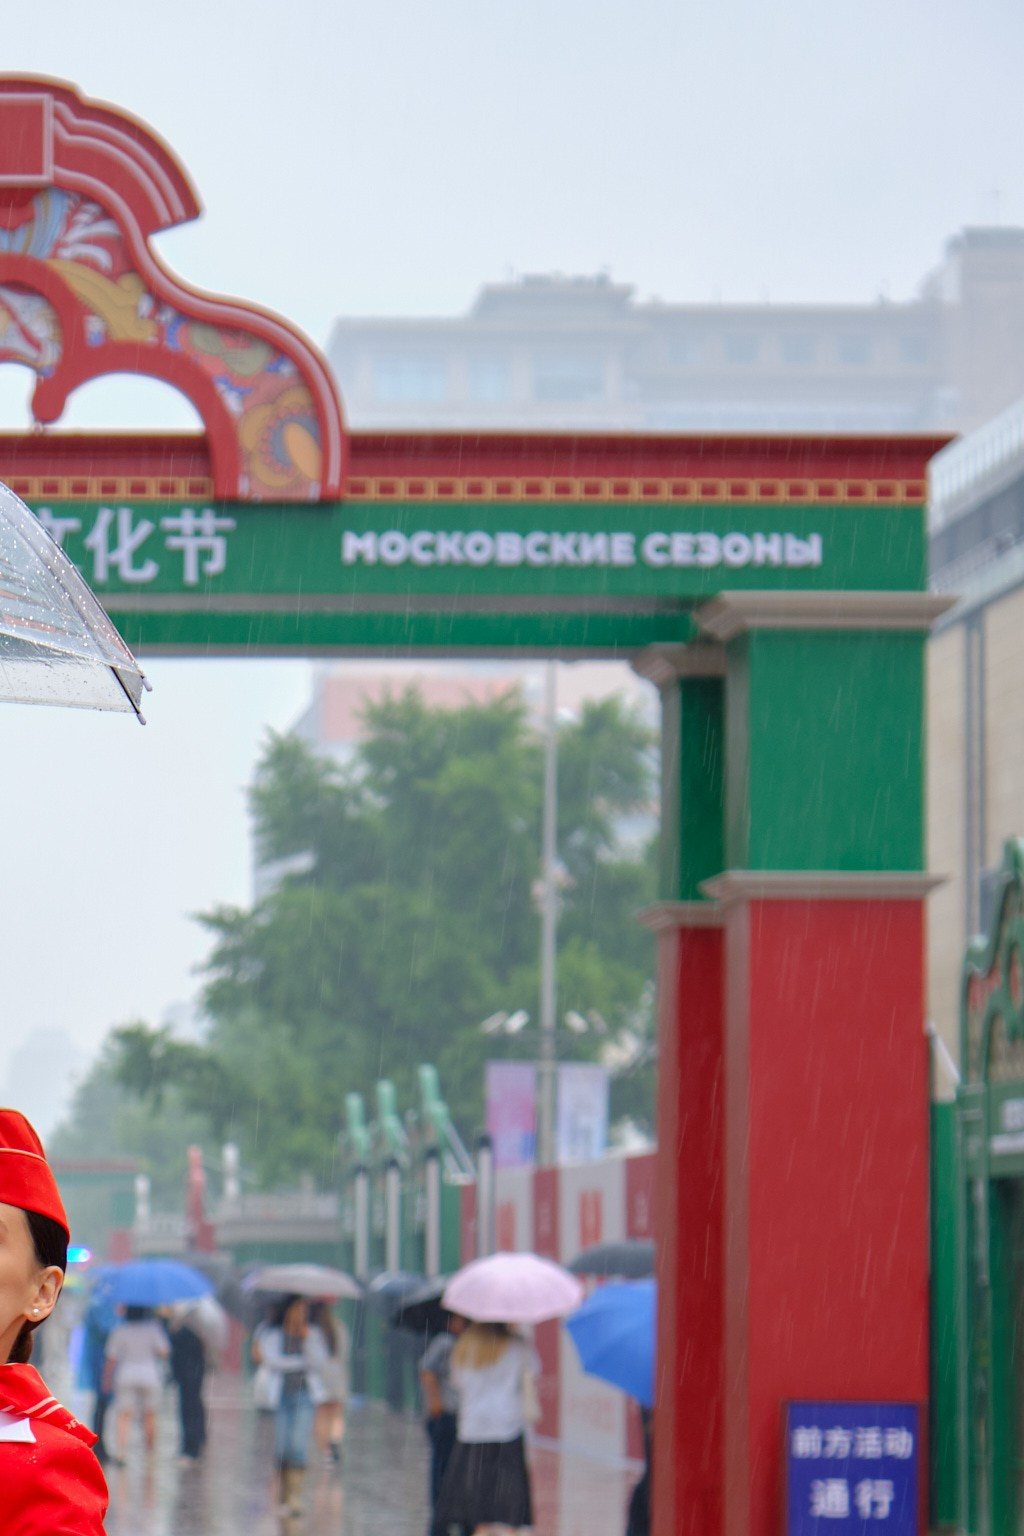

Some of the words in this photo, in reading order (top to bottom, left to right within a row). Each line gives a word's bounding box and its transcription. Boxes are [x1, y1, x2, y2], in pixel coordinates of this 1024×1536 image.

[341, 530, 636, 567] МОСКОВСКИЕ
[643, 532, 822, 567] СЕЗОНЫ
[792, 1425, 913, 1460] 前方活动
[809, 1477, 894, 1520] 通行
